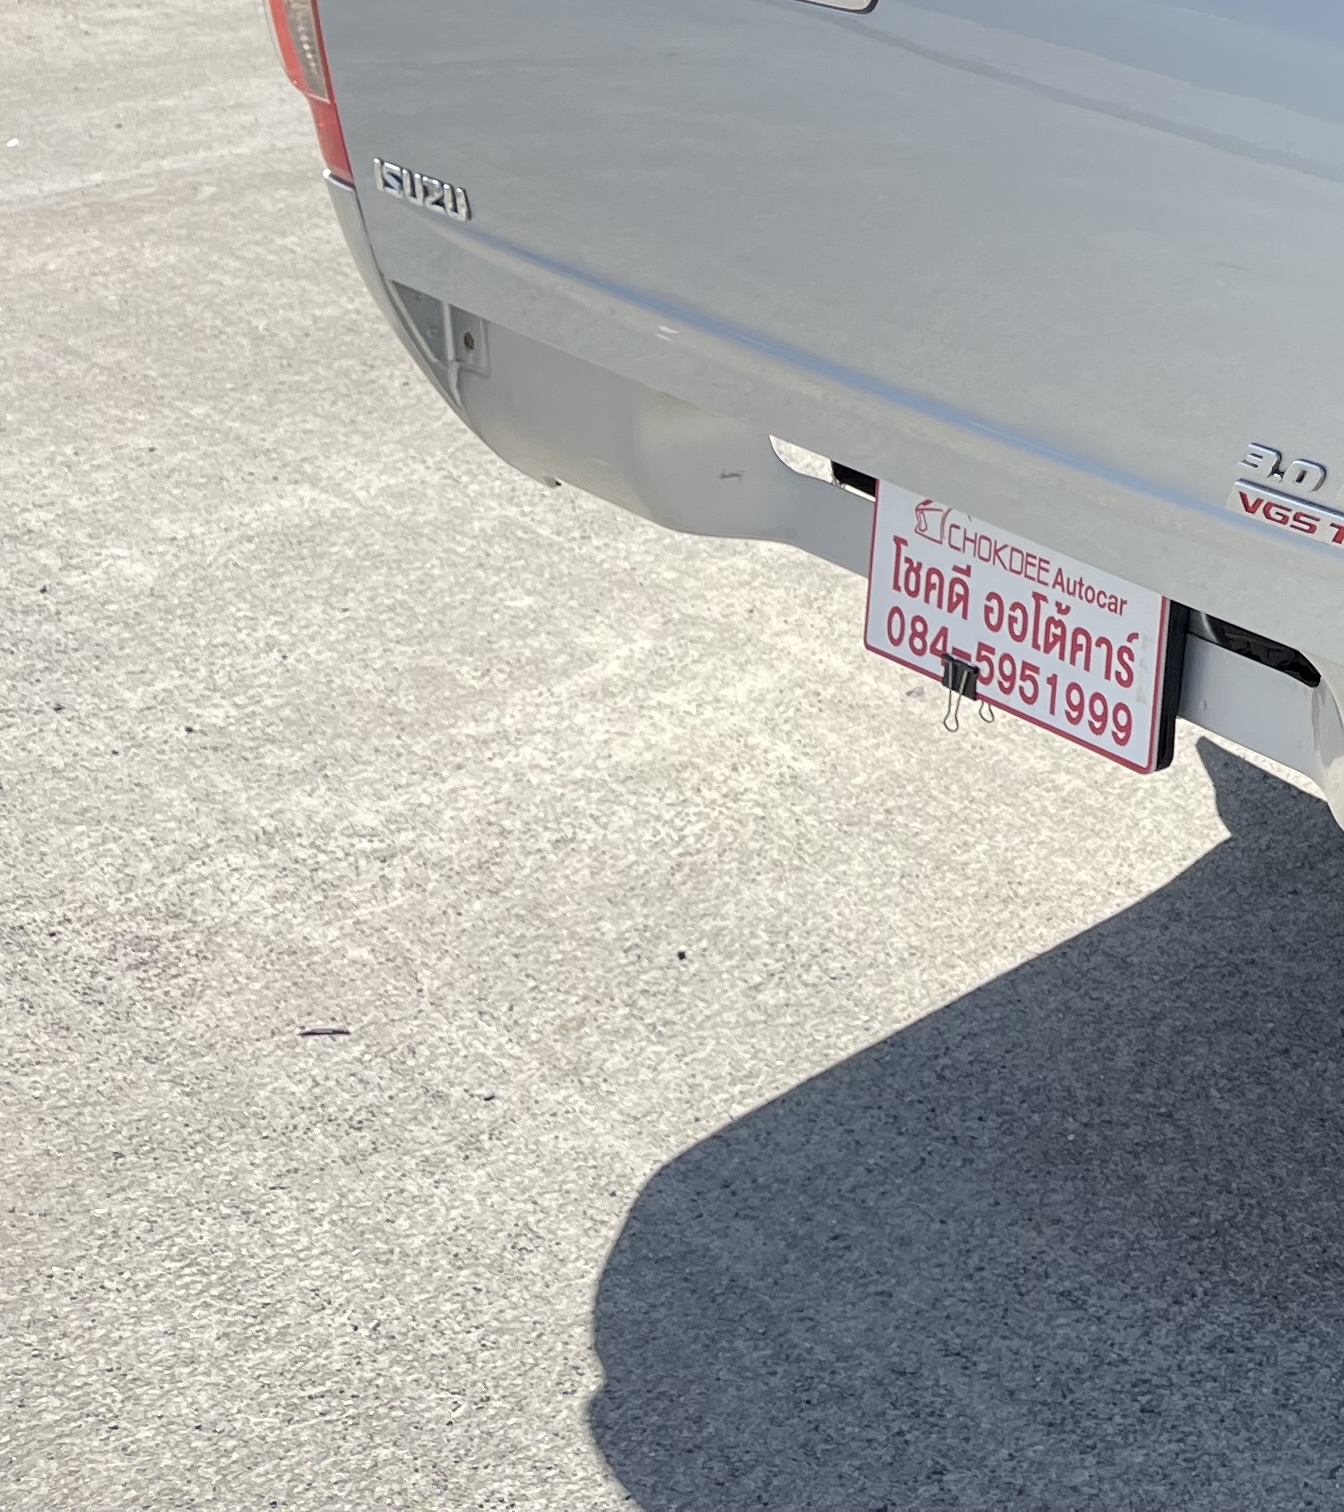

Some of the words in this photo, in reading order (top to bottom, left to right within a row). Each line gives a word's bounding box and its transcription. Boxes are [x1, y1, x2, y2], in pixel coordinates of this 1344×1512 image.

[373, 157, 471, 222] ISUZU
[1237, 442, 1328, 493] 3.0
[1238, 490, 1321, 535] VGS
[947, 522, 1051, 587] CHOKDEE
[1051, 567, 1128, 616] Autocar
[891, 534, 972, 621] โชคดี
[983, 590, 1140, 689] ออโต้คาร์
[886, 605, 1133, 747] 084-5951999
